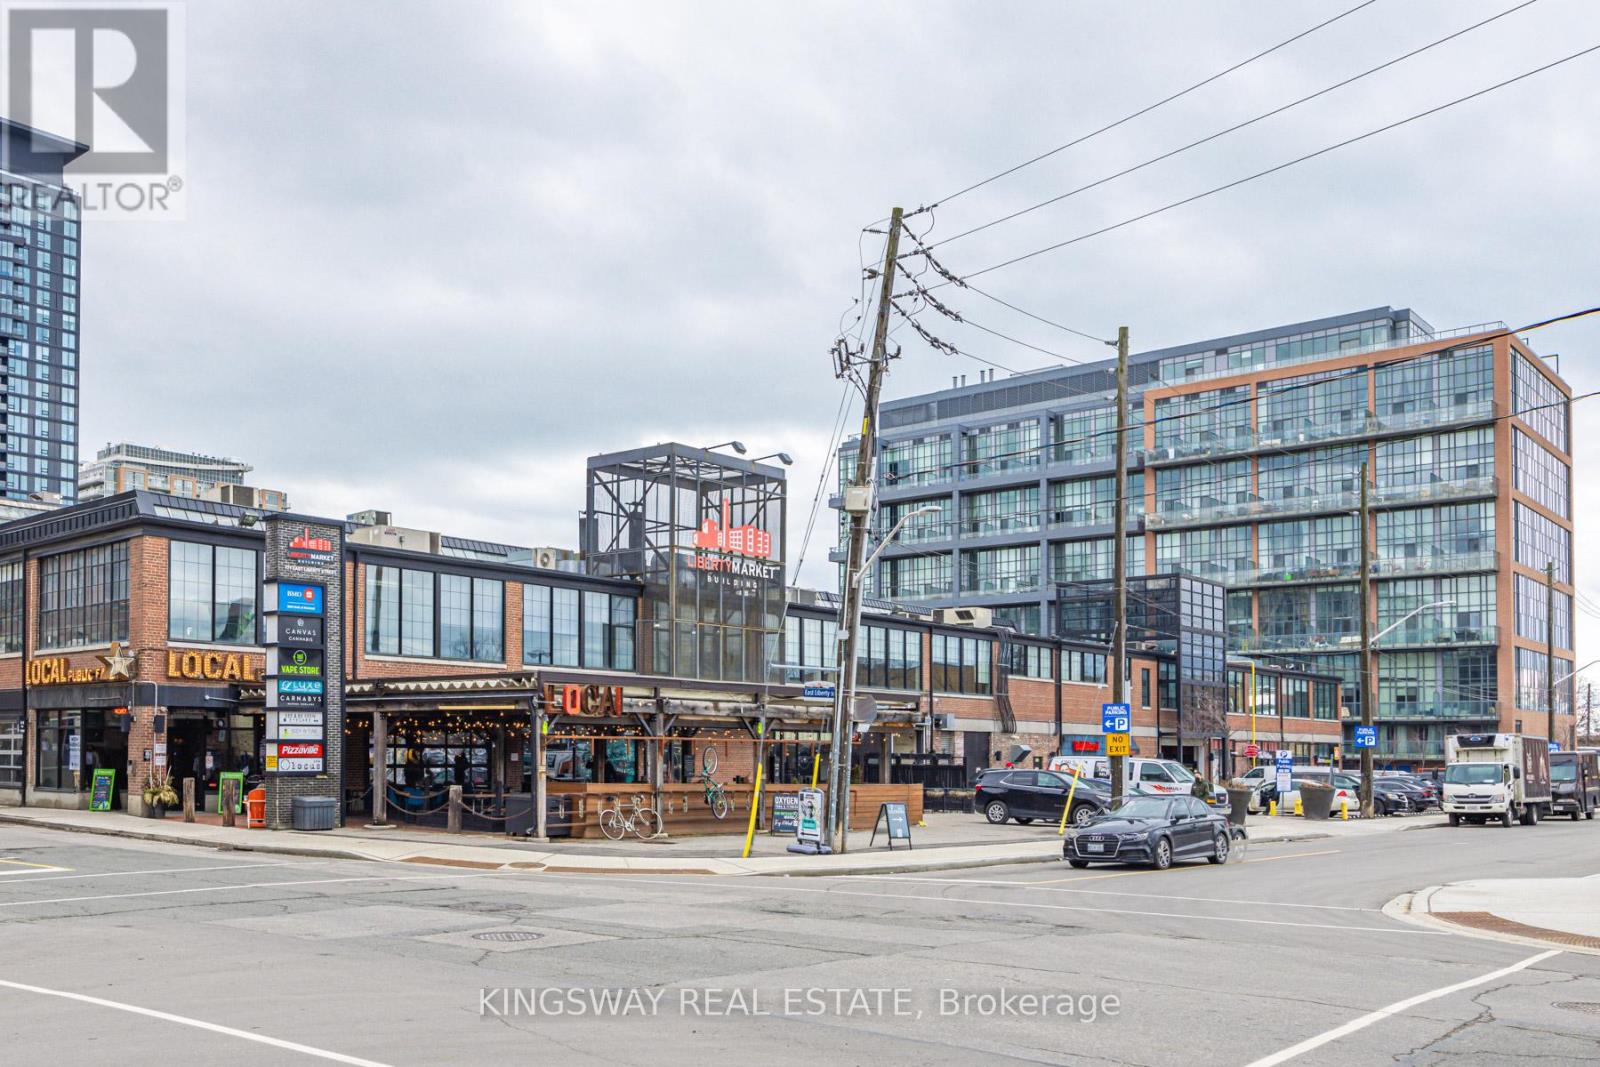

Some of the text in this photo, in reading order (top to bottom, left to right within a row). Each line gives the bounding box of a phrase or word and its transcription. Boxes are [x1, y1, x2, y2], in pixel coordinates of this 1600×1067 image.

[707, 576, 757, 588] BUILDING
[285, 628, 317, 636] CANVAS
[168, 649, 256, 681] LOCAL
[281, 665, 320, 674] VAPE STORE
[25, 657, 67, 685] LOCAL
[67, 668, 93, 682] PUBLIC
[815, 688, 830, 697] Liberty
[280, 694, 322, 702] CARNABYS
